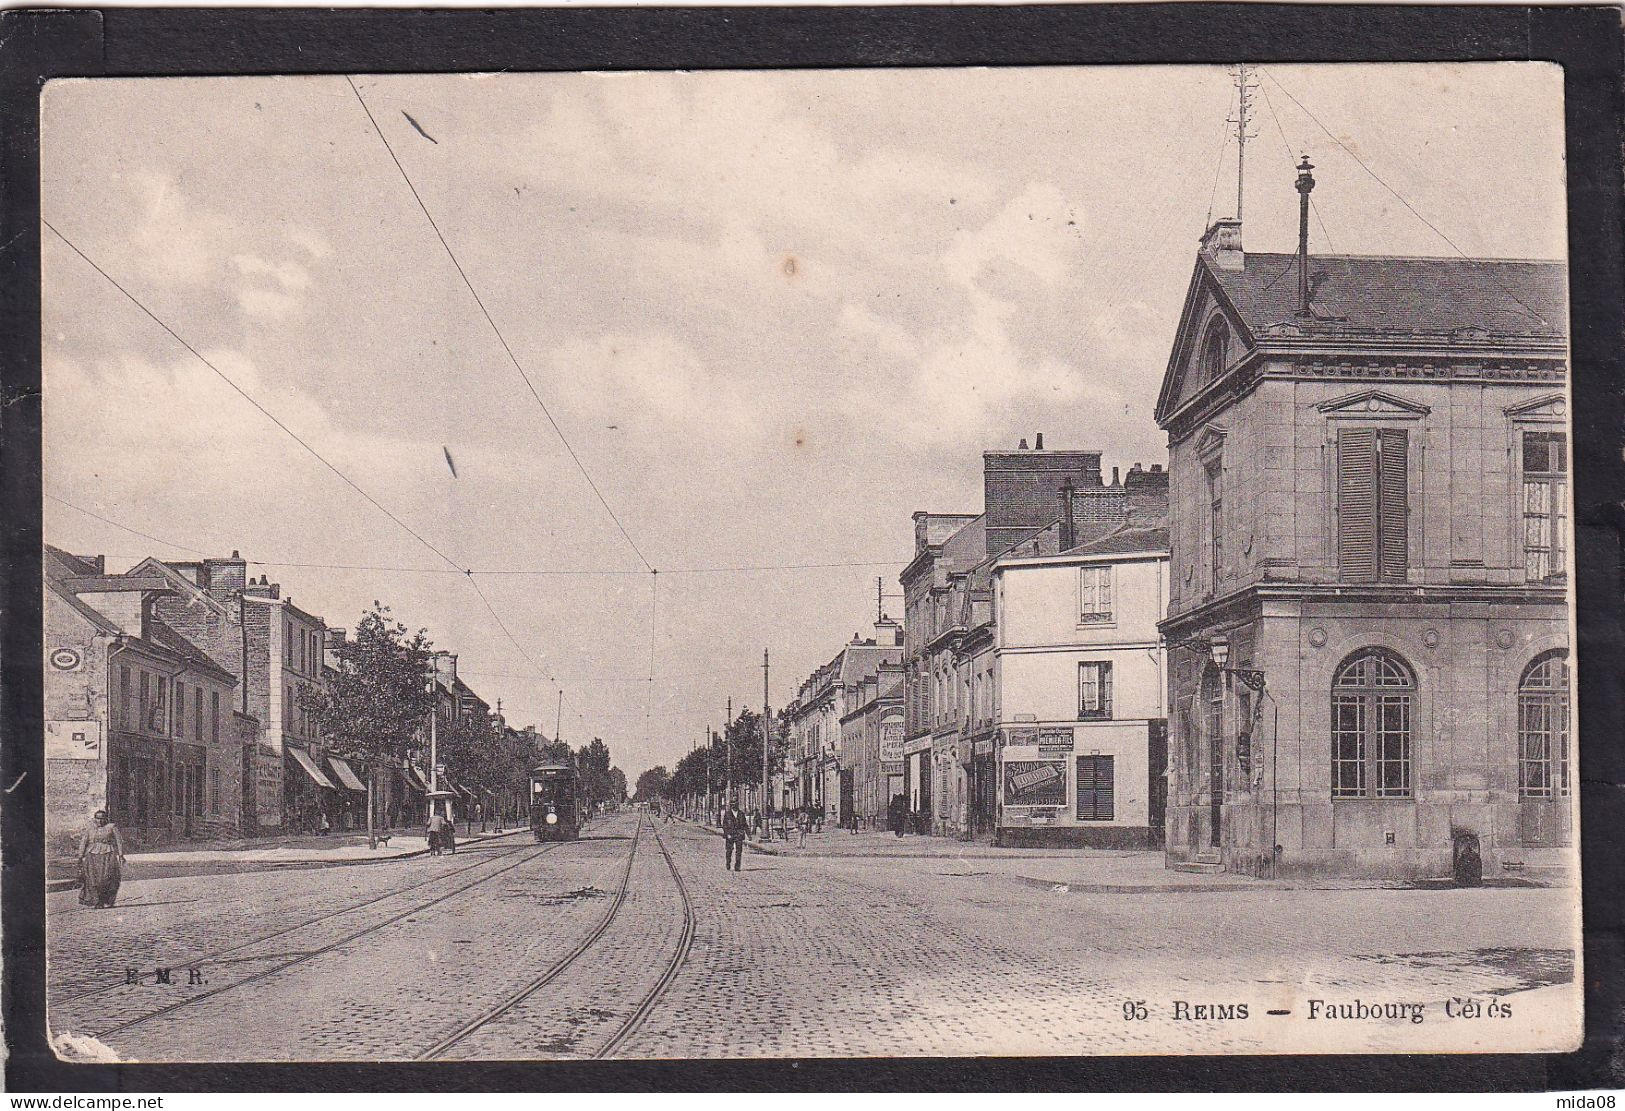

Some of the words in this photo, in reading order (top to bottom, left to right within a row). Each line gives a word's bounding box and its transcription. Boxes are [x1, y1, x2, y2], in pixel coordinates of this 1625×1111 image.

[188, 968, 209, 985] R.
[1122, 1000, 1149, 1021] 95
[1172, 1000, 1250, 1020] REIMS
[1307, 999, 1425, 1024] Faubourg
